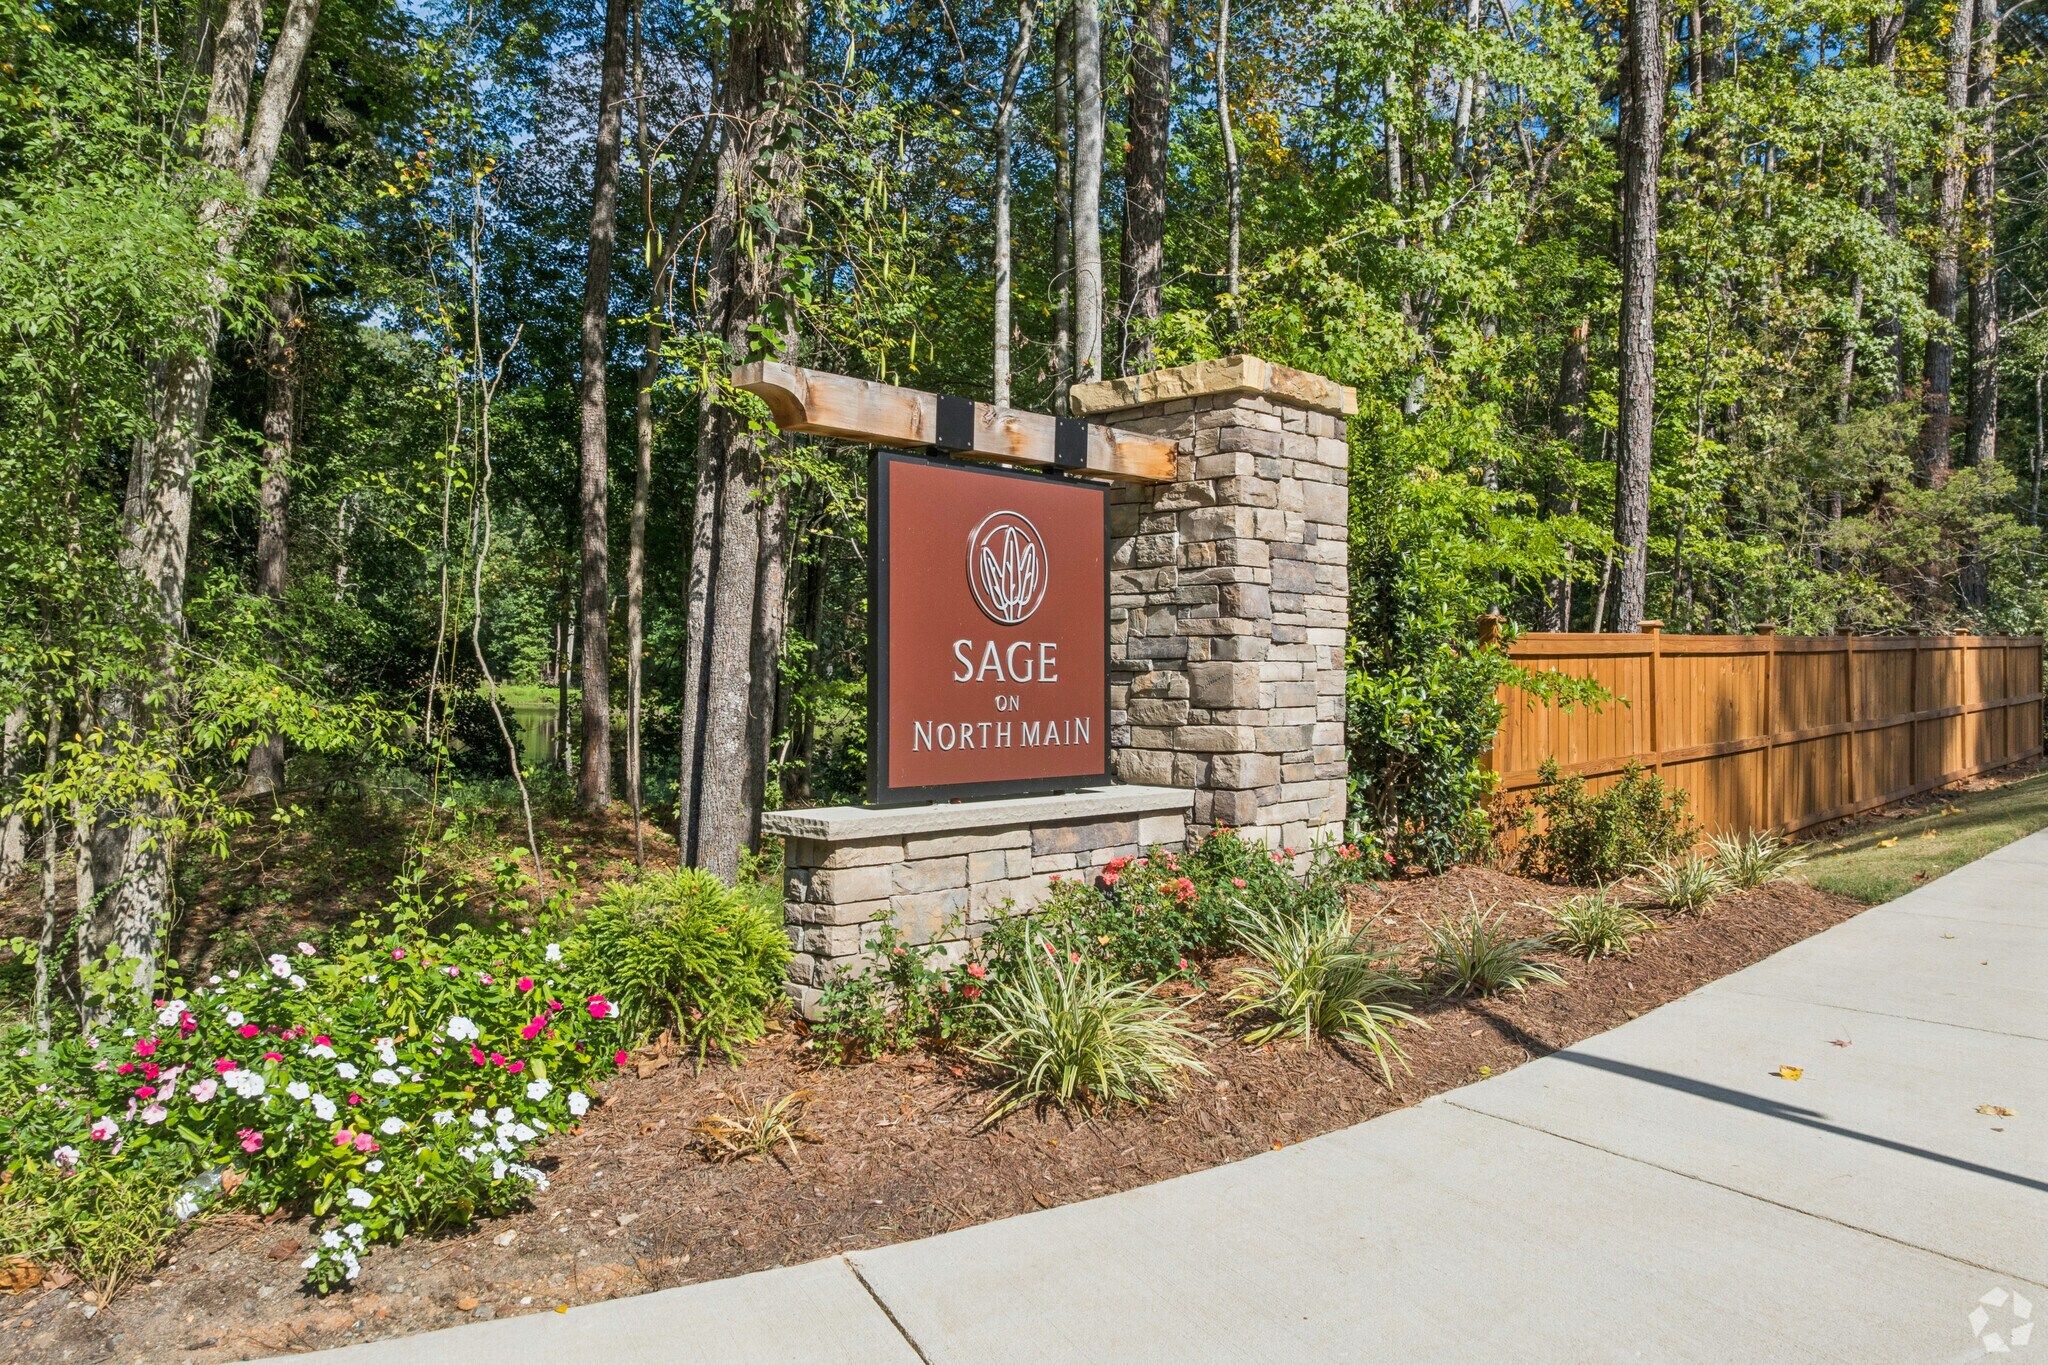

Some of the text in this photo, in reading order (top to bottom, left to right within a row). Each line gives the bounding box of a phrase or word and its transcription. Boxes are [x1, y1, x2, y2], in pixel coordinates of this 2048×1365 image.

[952, 639, 1058, 683] SAGE
[994, 694, 1020, 712] ON
[912, 716, 1090, 752] NORTH MAIN
